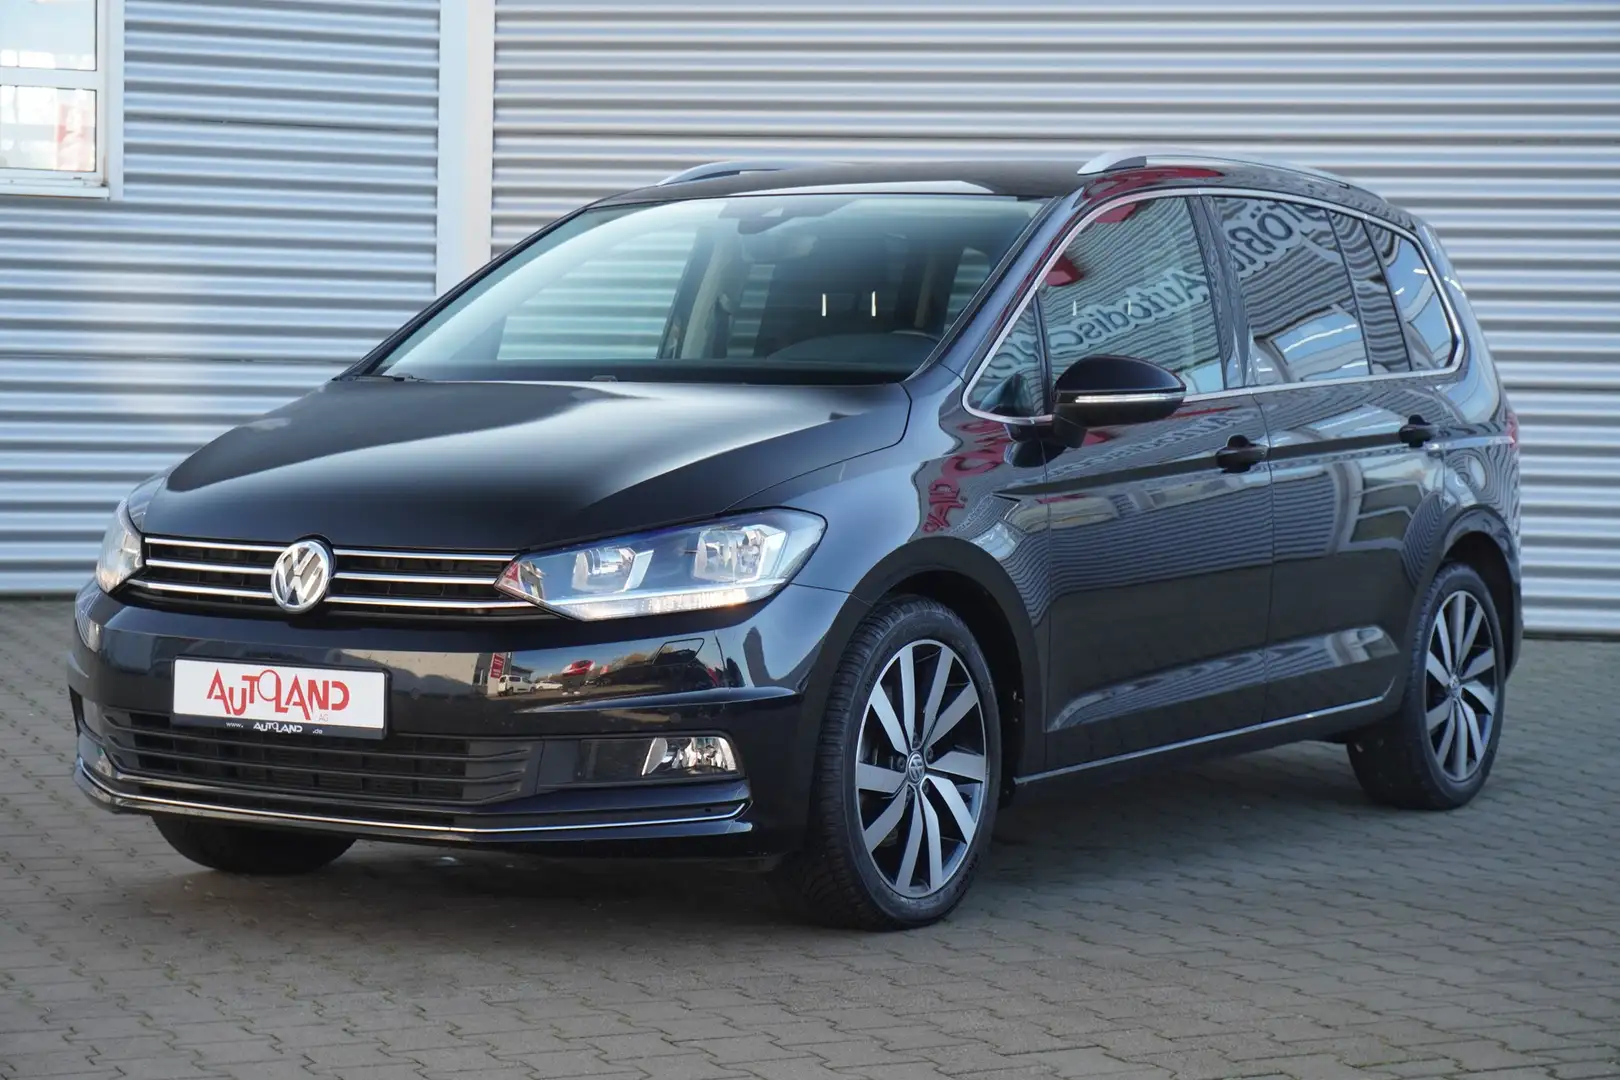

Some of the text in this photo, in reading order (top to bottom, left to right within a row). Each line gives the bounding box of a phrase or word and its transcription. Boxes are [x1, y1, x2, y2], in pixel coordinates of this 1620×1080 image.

[272, 541, 328, 610] VW
[207, 668, 350, 720] AUTOLAND
[253, 721, 302, 733] AUTOLAND
[318, 713, 329, 722] AG
